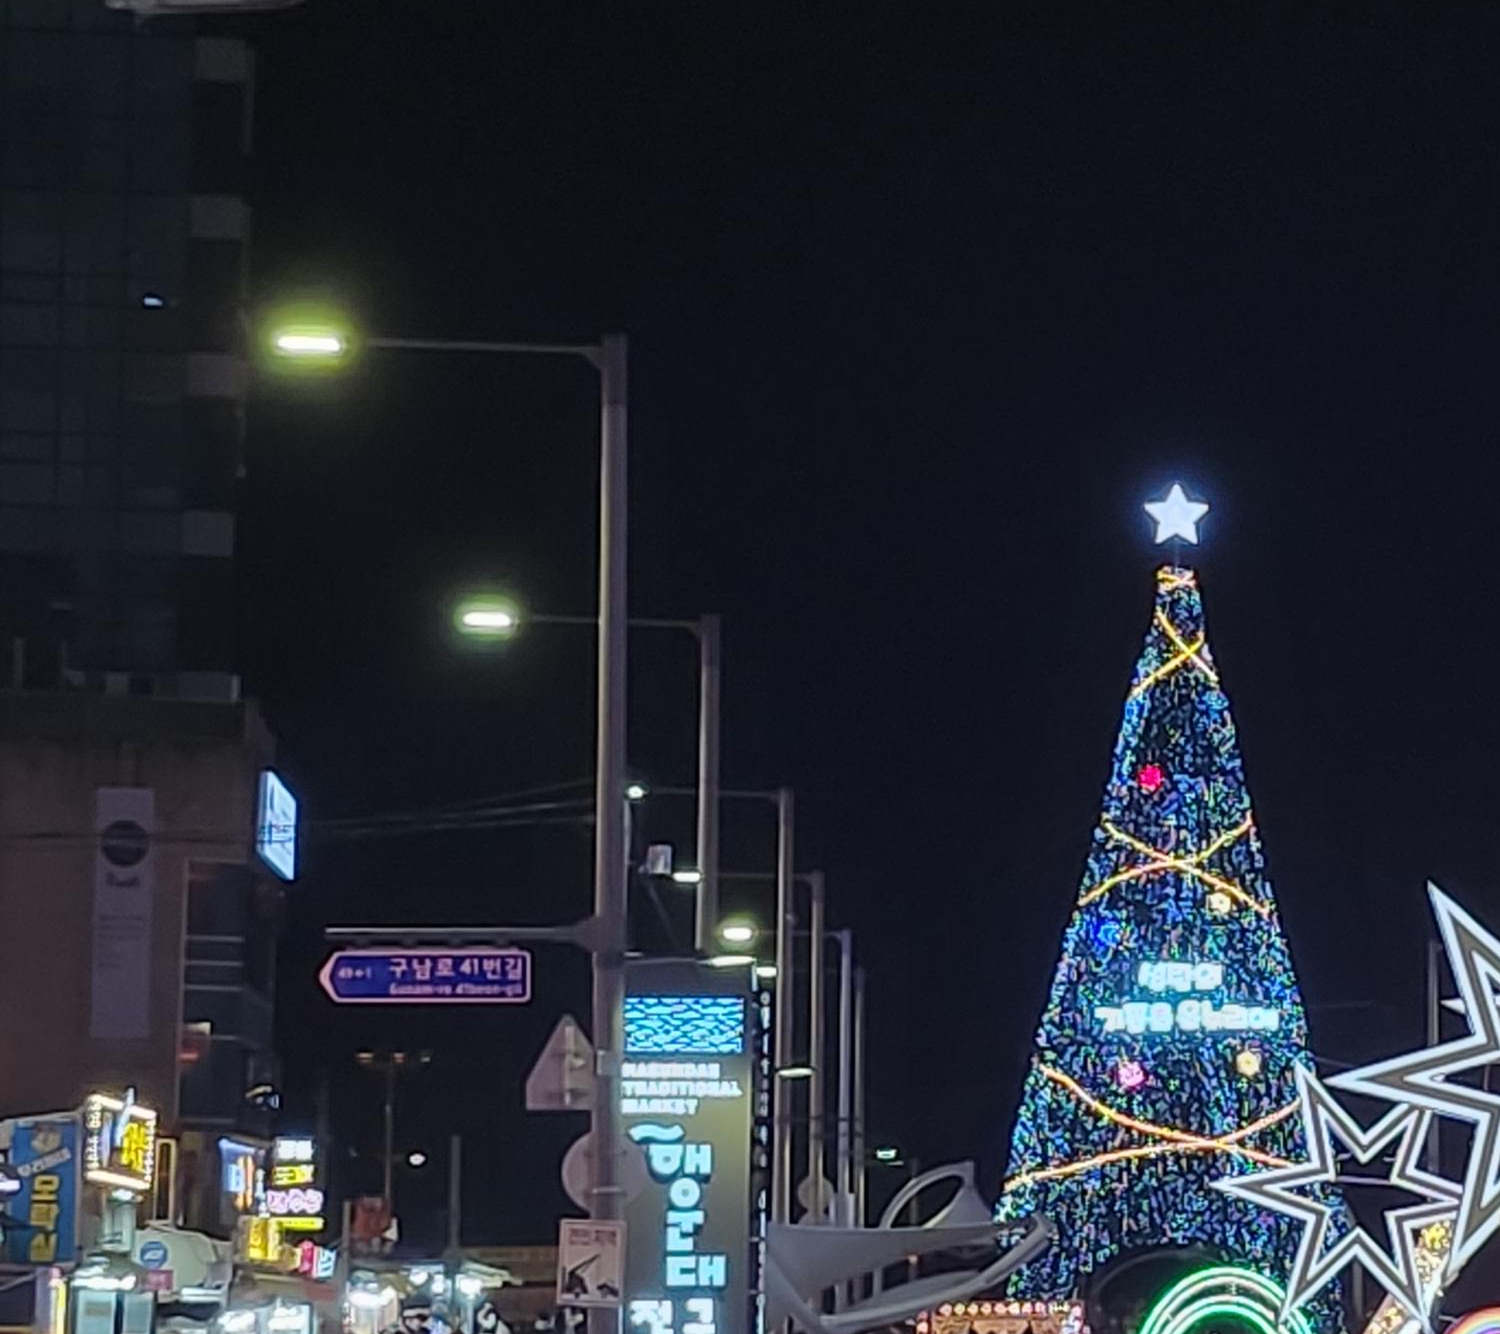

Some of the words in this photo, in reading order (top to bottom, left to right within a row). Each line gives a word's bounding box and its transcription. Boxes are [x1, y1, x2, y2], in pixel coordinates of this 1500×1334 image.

[621, 1080, 743, 1098] TRADITIONAL
[621, 1098, 698, 1116] MARKET
[627, 1123, 727, 1288] 해운대
